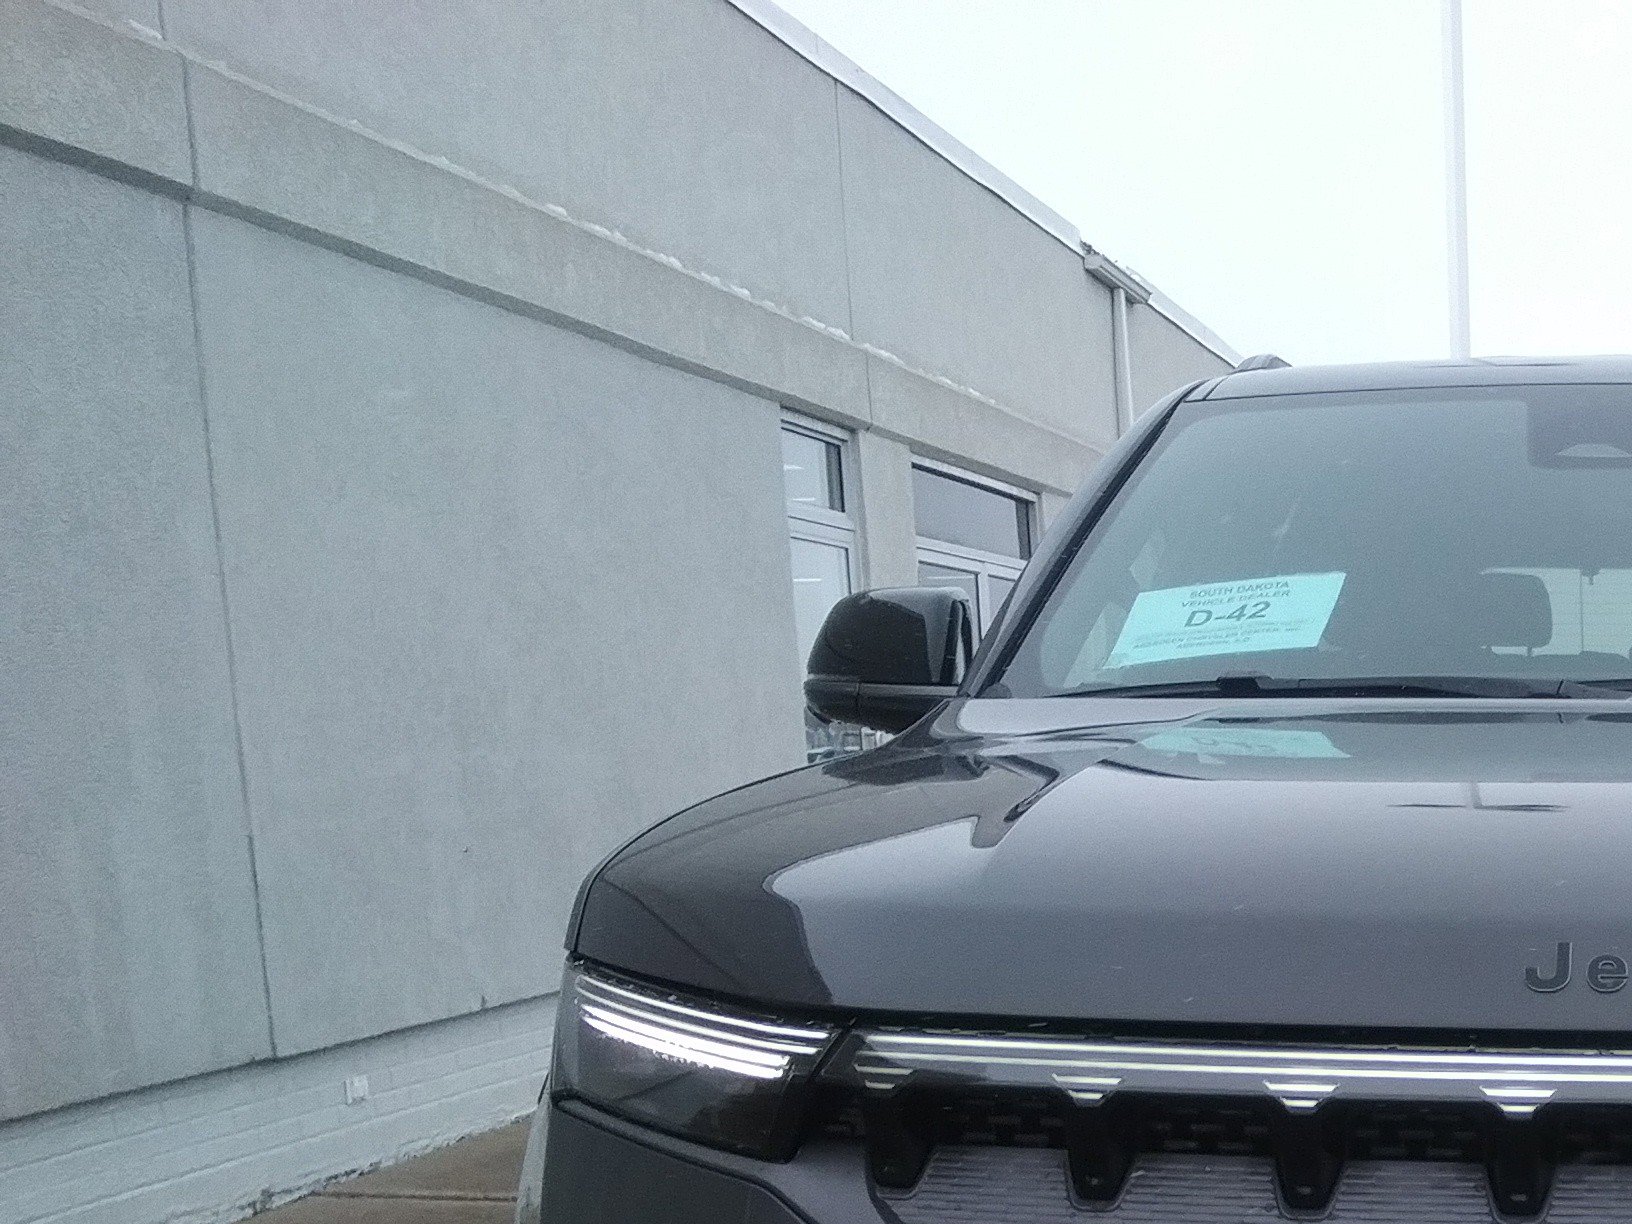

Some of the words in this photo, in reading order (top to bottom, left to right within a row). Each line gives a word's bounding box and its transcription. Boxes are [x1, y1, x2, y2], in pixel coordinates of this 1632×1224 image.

[1181, 596, 1235, 608] VEHICLE
[1239, 589, 1291, 600] DEALER
[1190, 586, 1233, 599] SOUTH
[1237, 581, 1290, 594] DAKOTA
[1183, 600, 1272, 628] D-42
